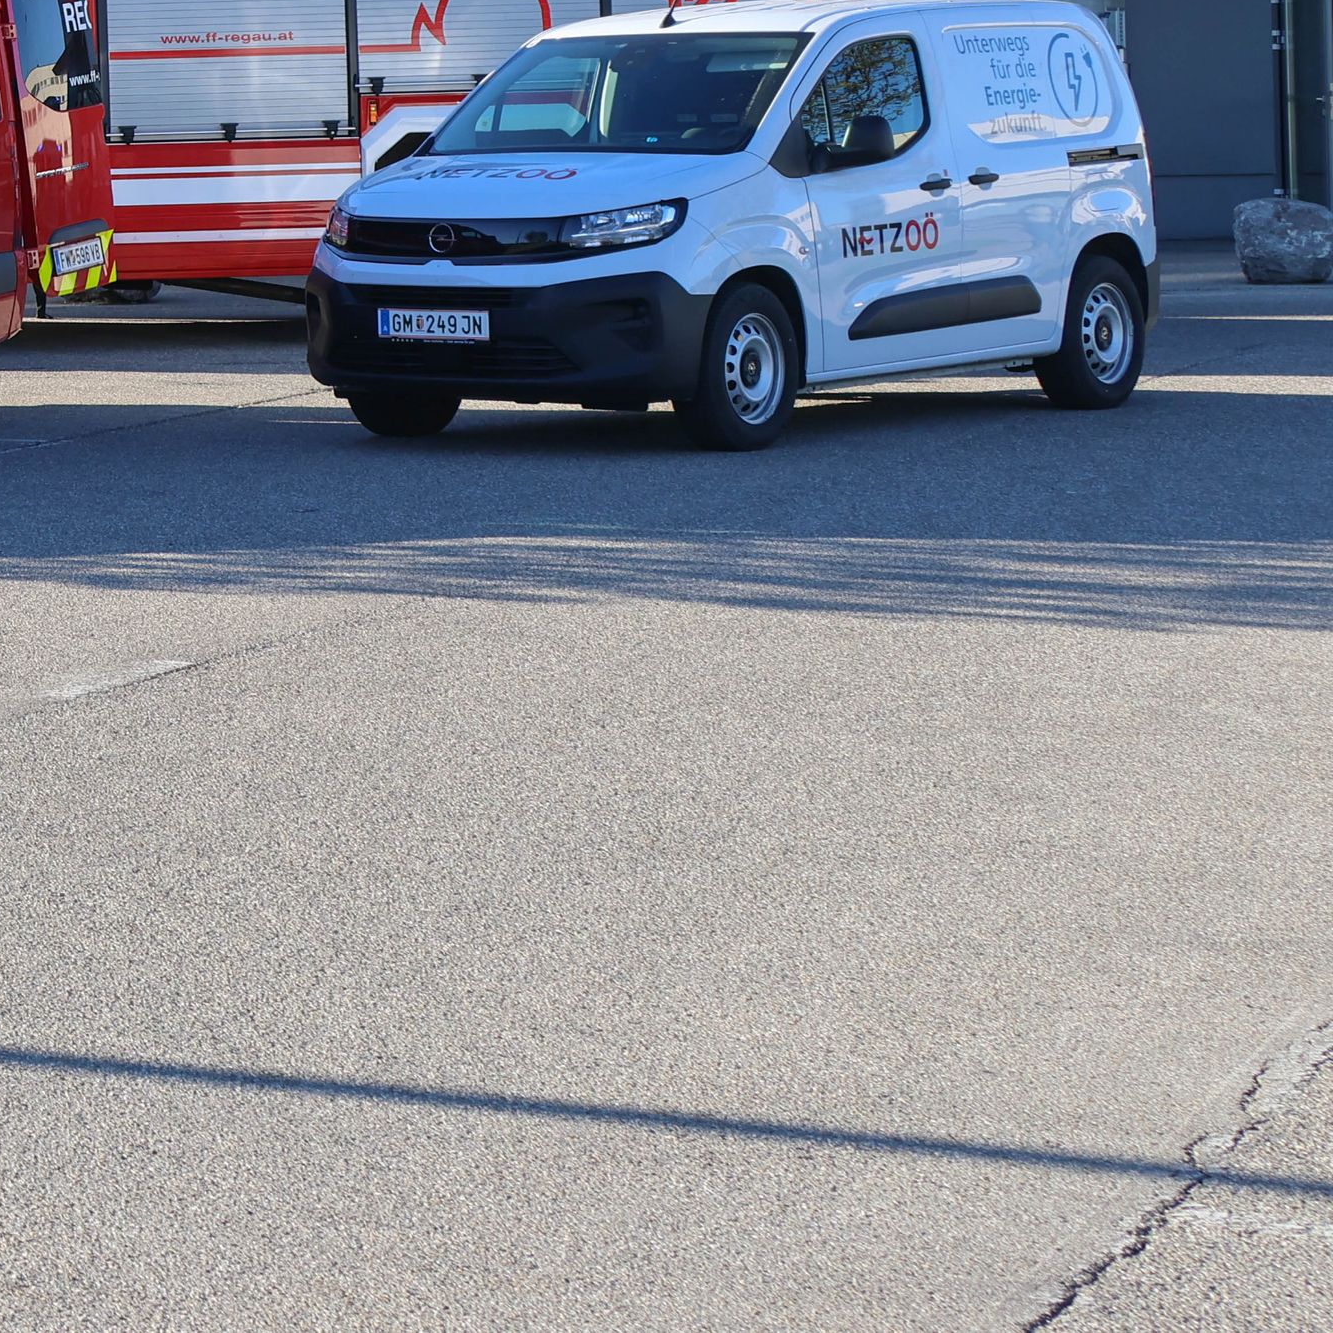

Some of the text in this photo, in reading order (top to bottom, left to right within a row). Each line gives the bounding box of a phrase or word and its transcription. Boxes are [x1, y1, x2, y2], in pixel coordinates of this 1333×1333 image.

[160, 28, 294, 47] www.ff-regau.at
[953, 34, 1030, 56] Unterwegs
[990, 57, 1036, 80] für die
[984, 83, 1041, 109] Energie-
[990, 112, 1047, 135] zukunft.
[841, 210, 940, 259] NETZOÖ
[393, 314, 413, 333] GM
[426, 315, 458, 334] 249
[462, 315, 483, 335] JN
